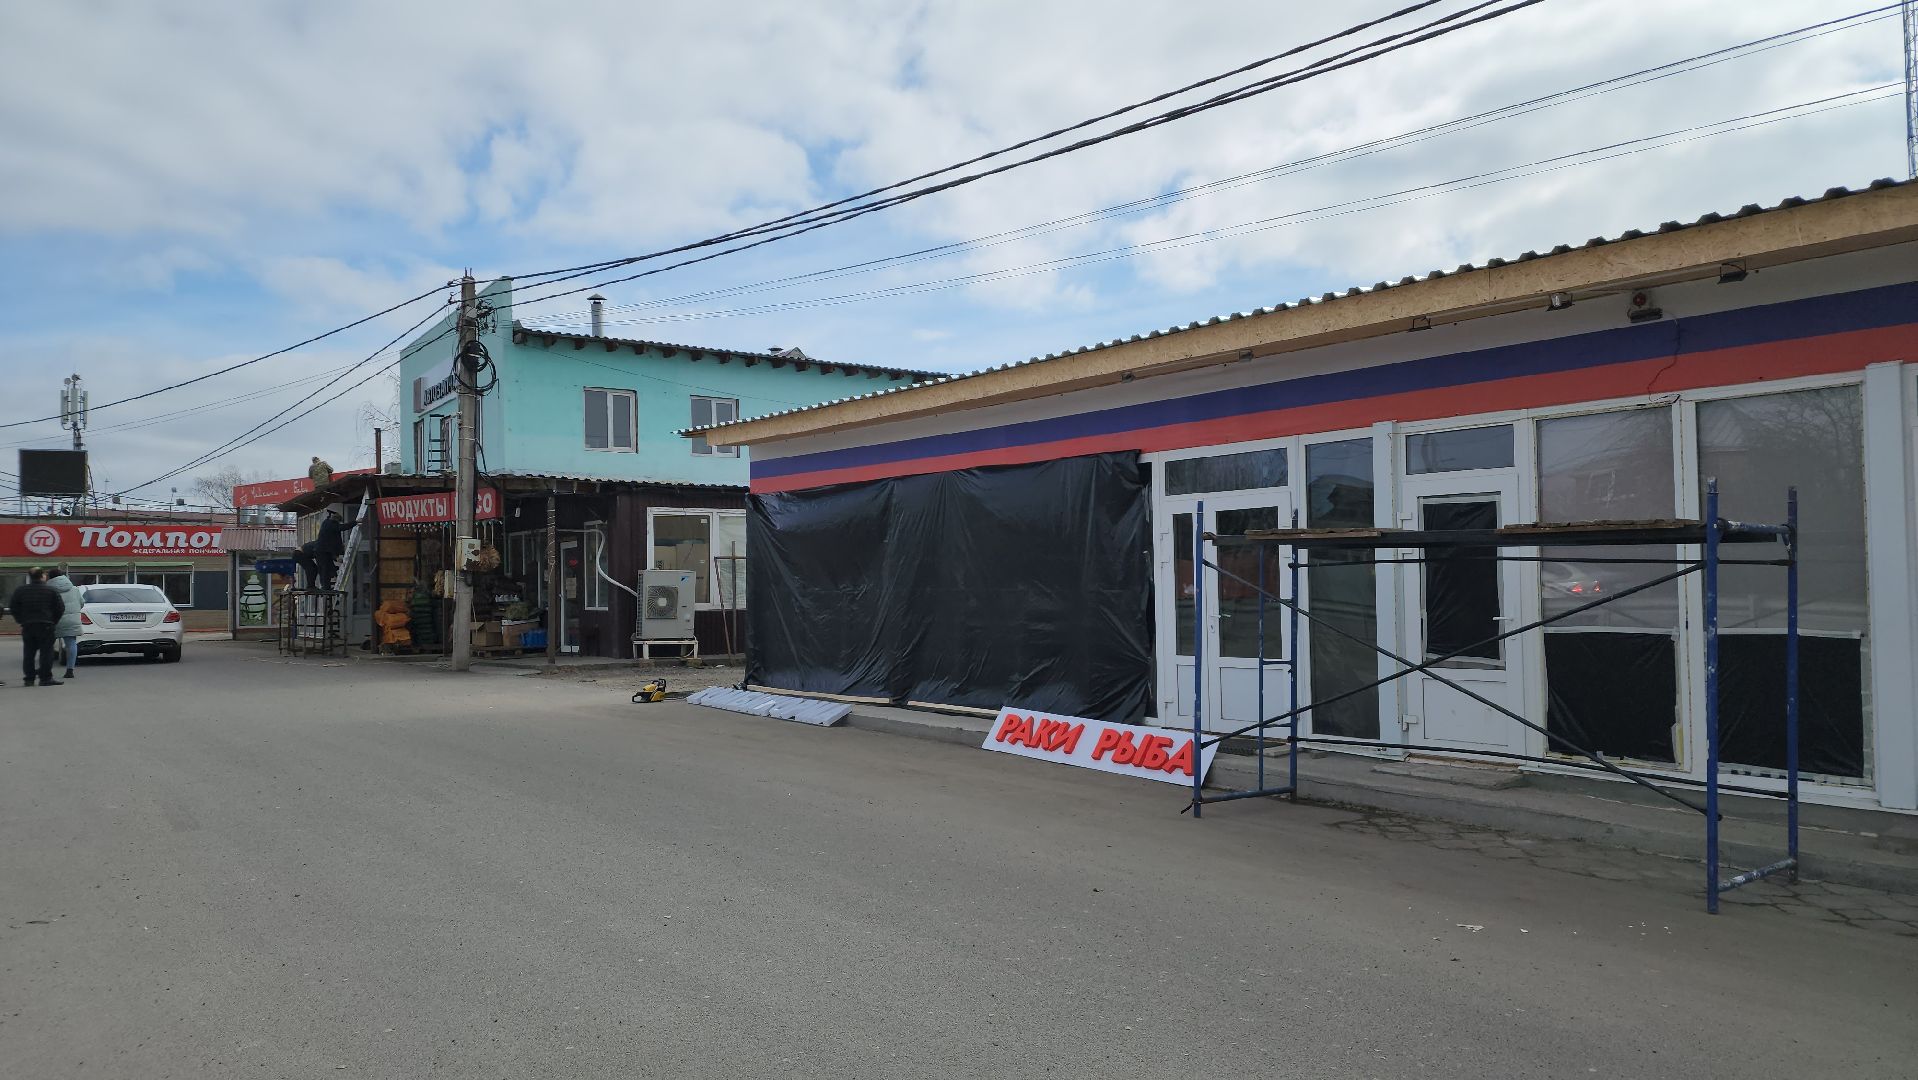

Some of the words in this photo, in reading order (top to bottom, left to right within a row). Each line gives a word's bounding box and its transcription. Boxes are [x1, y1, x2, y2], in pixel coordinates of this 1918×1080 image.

[381, 498, 447, 521] ПРОДУКТЫ
[995, 713, 1086, 754] РАКИ
[1091, 728, 1195, 776] РЫБА
